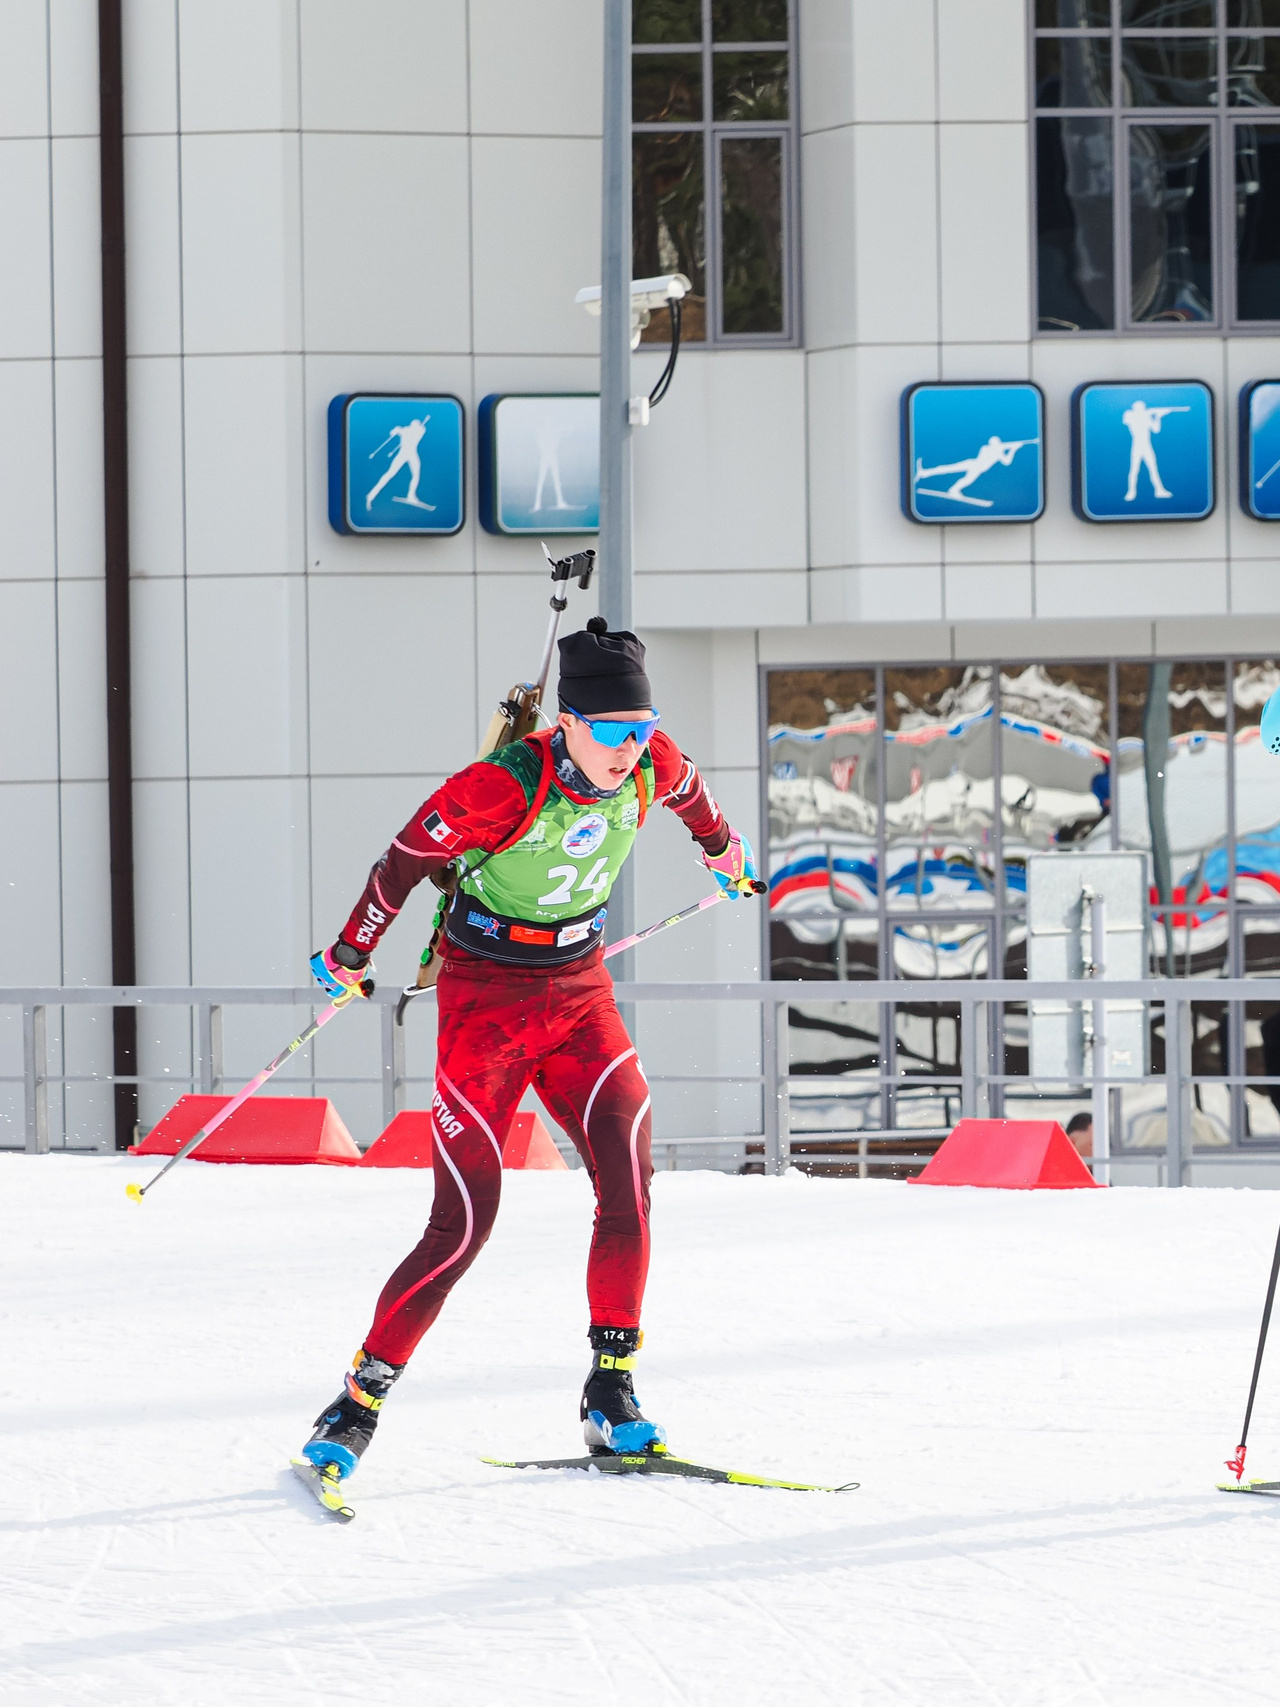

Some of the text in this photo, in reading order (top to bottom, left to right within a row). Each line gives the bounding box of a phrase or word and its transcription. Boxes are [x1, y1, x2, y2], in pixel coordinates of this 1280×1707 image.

[537, 856, 610, 906] 24
[433, 1091, 465, 1139] РТИЯ
[603, 1330, 626, 1341] 174
[621, 1457, 647, 1465] FISCHER
